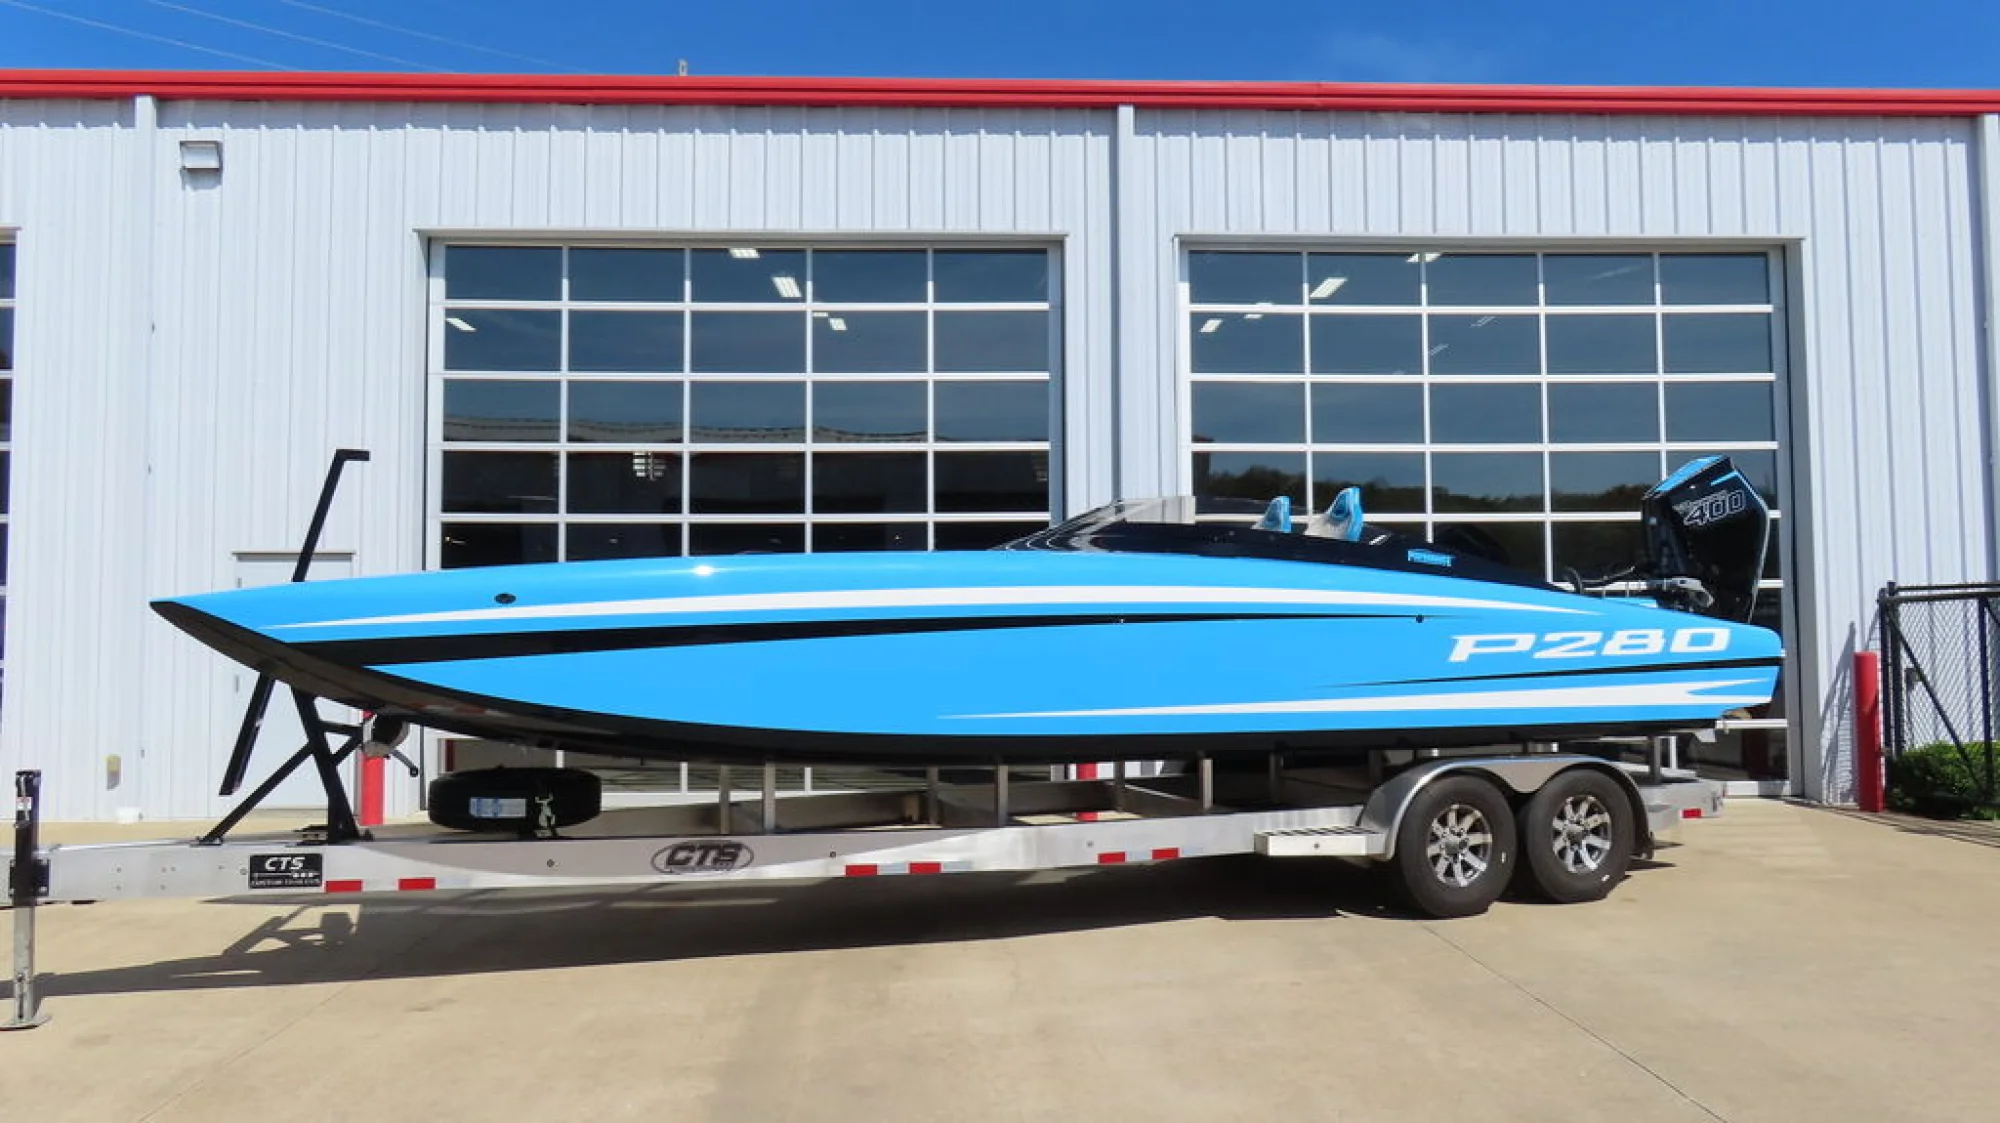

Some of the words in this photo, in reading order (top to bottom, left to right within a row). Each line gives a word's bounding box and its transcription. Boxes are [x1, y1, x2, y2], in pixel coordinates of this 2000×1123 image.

[1683, 490, 1745, 526] 400
[1449, 628, 1730, 663] P280
[265, 856, 305, 871] CTS
[666, 844, 743, 867] CTS
